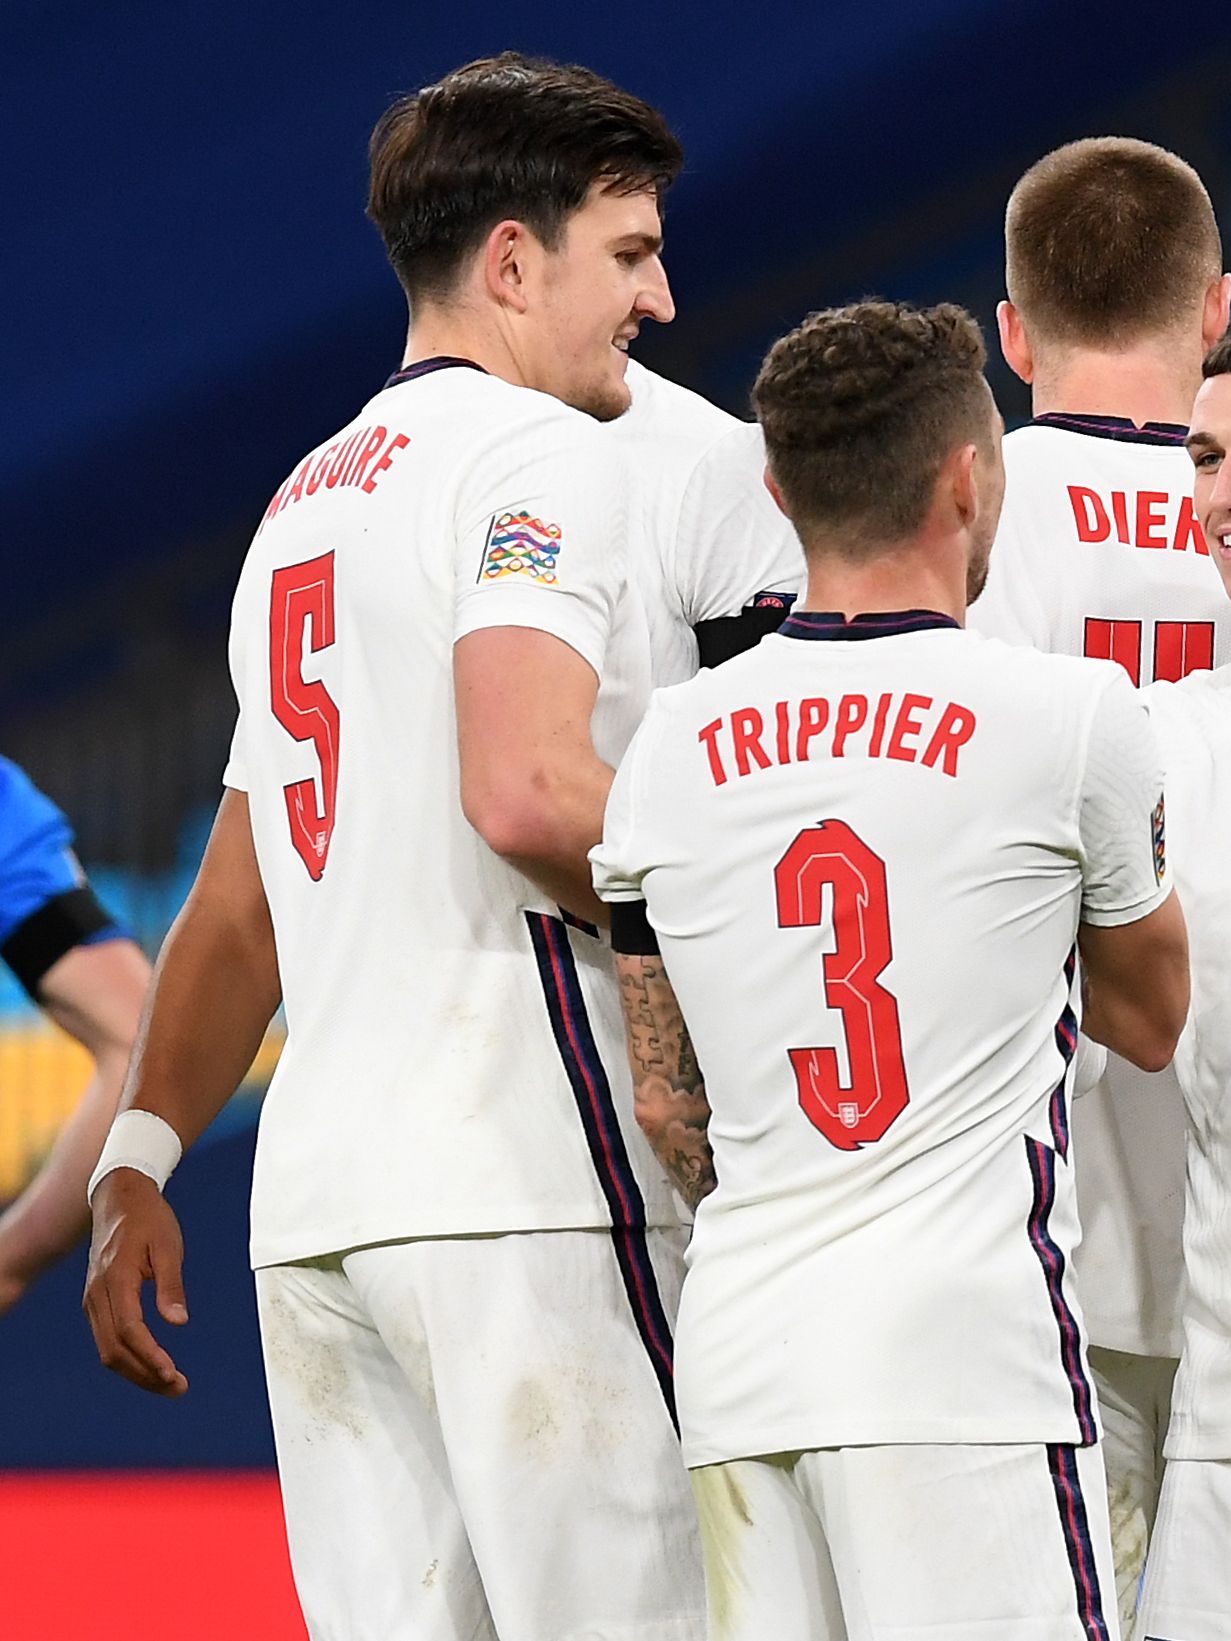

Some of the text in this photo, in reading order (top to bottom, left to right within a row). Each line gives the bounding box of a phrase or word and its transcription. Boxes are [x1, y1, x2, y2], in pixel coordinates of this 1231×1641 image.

[257, 426, 411, 537] MAGUIRE
[269, 549, 340, 882] 5
[698, 692, 977, 787] TRIPPIER
[774, 818, 910, 1152] 3
